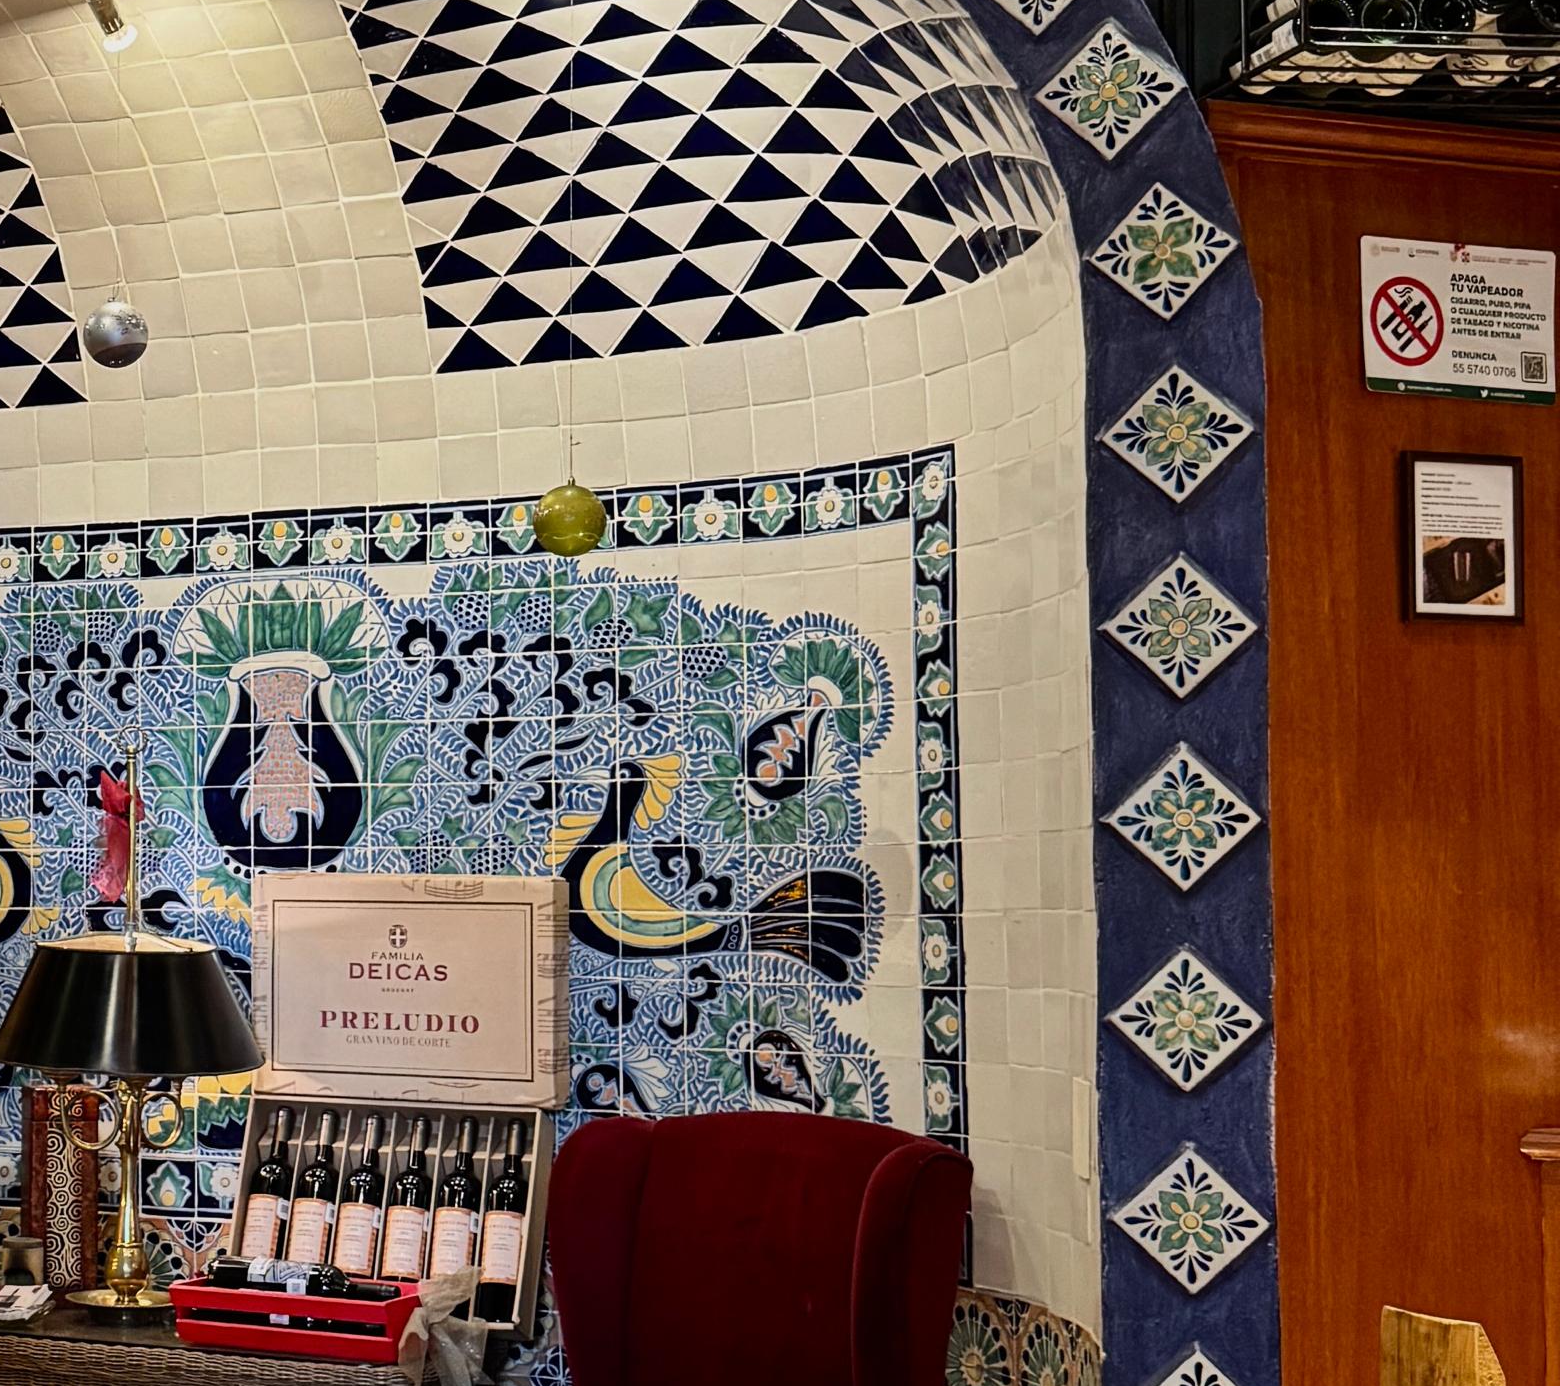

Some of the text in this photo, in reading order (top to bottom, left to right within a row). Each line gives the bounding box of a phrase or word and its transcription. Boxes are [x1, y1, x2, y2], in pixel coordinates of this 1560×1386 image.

[1450, 273, 1486, 284] APAGA
[1450, 283, 1524, 298] TU VAPEADOR
[1450, 296, 1531, 310] CIGARRO, PURO, PIPA
[1458, 307, 1503, 318] CUALQUIER
[1504, 311, 1546, 322] PRODUCTO
[1450, 317, 1462, 325] DE
[1463, 318, 1494, 328] TABACO
[1503, 321, 1540, 331] NICOTINA
[1451, 327, 1522, 340] ANTES DE ENTRAR
[1451, 350, 1497, 361] DENUNCIA
[1452, 363, 1517, 378] 55 5740 0706
[371, 952, 424, 961] FAMILIA
[349, 963, 449, 982] DEICAS
[320, 1010, 480, 1034] PRELUDIO
[346, 1034, 452, 1049] GRAN VINO DE CORTE
